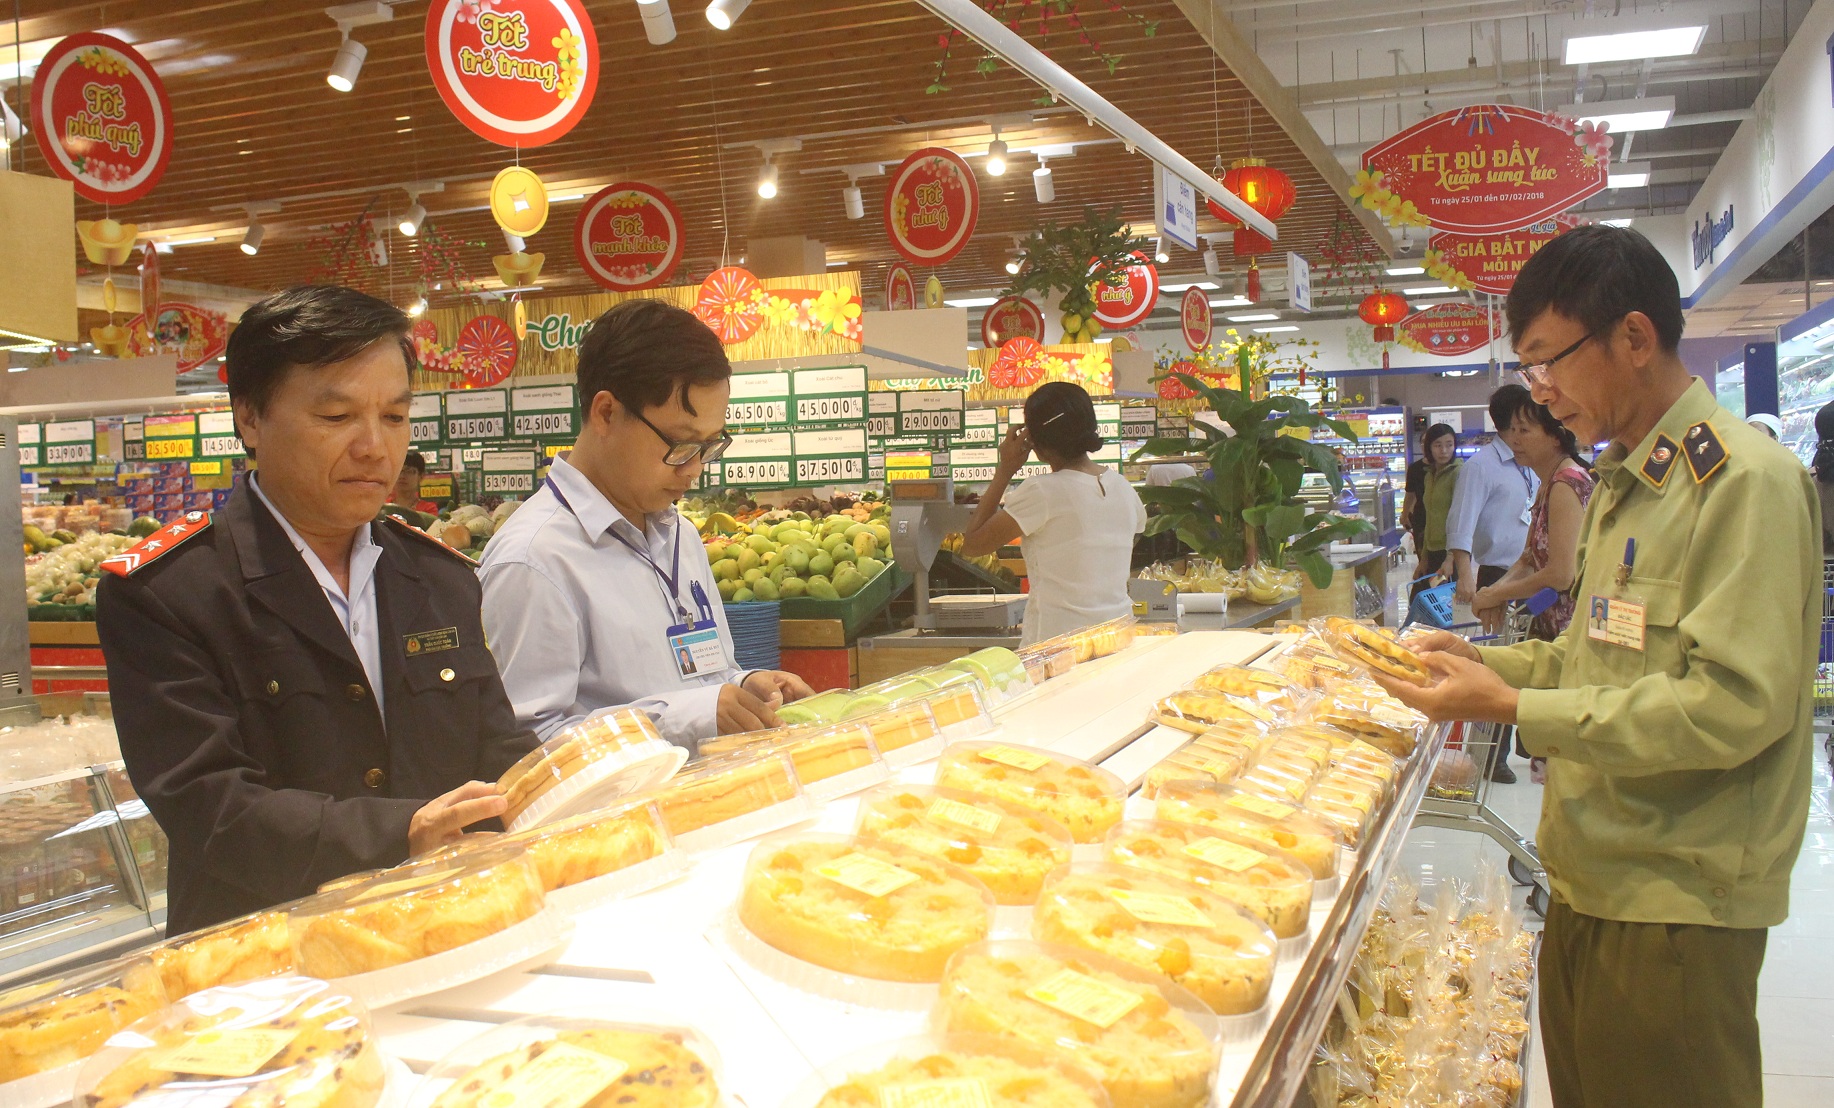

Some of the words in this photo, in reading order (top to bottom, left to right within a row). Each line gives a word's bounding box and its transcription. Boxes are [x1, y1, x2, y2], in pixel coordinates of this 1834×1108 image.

[479, 11, 527, 50] Tết
[459, 47, 495, 76] trẻ
[496, 51, 558, 91] trung
[85, 83, 125, 118] Tết
[67, 112, 104, 143] phú
[105, 122, 142, 157] quý
[1408, 145, 1450, 172] TẾT
[1454, 144, 1486, 170] ĐỦ
[1435, 168, 1481, 192] Xuân
[1486, 169, 1534, 187] sung
[1531, 164, 1557, 181] túc
[915, 180, 943, 206] Tết
[1442, 197, 1460, 205] ngày
[1461, 195, 1483, 203] 25/01
[1500, 192, 1545, 202] 07/02/2018
[611, 213, 643, 237] Tết
[912, 207, 938, 228] như
[938, 205, 949, 231] ý
[592, 237, 633, 256] mạnh
[1457, 239, 1486, 257] GIÁ
[1483, 257, 1508, 272] MỖI
[726, 405, 773, 419] 36.500
[800, 400, 849, 416] 45.000
[450, 421, 492, 435] 81.500
[516, 416, 560, 431] 42.500
[904, 415, 948, 428] 29.000
[966, 429, 985, 439] 600
[49, 447, 82, 459] 33.900
[148, 442, 184, 455] 25.500
[728, 464, 775, 478] 68.900
[799, 459, 852, 476] 37.500
[954, 467, 987, 478] 56.500
[486, 477, 523, 487] 53.900
